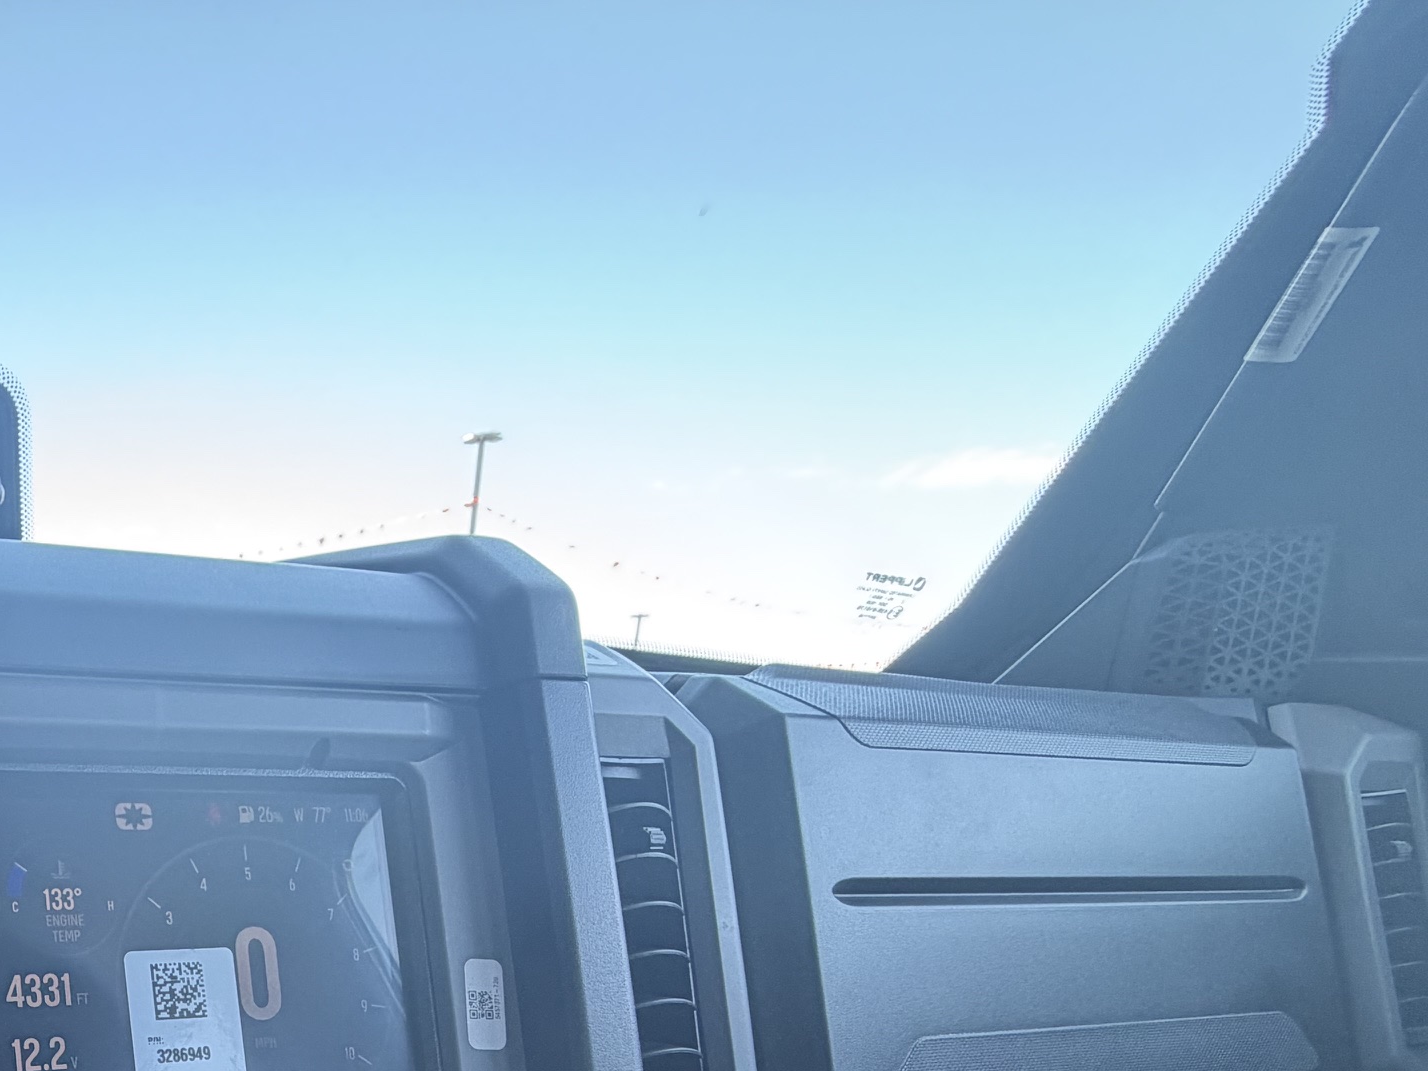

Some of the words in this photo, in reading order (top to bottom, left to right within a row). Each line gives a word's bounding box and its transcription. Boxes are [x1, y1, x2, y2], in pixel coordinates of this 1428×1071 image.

[294, 807, 304, 822] W
[46, 914, 84, 927] ENGINE
[52, 930, 81, 943] TEMP
[6, 973, 72, 1008] 4331
[77, 993, 88, 1005] FT
[157, 1046, 211, 1064] 3286949
